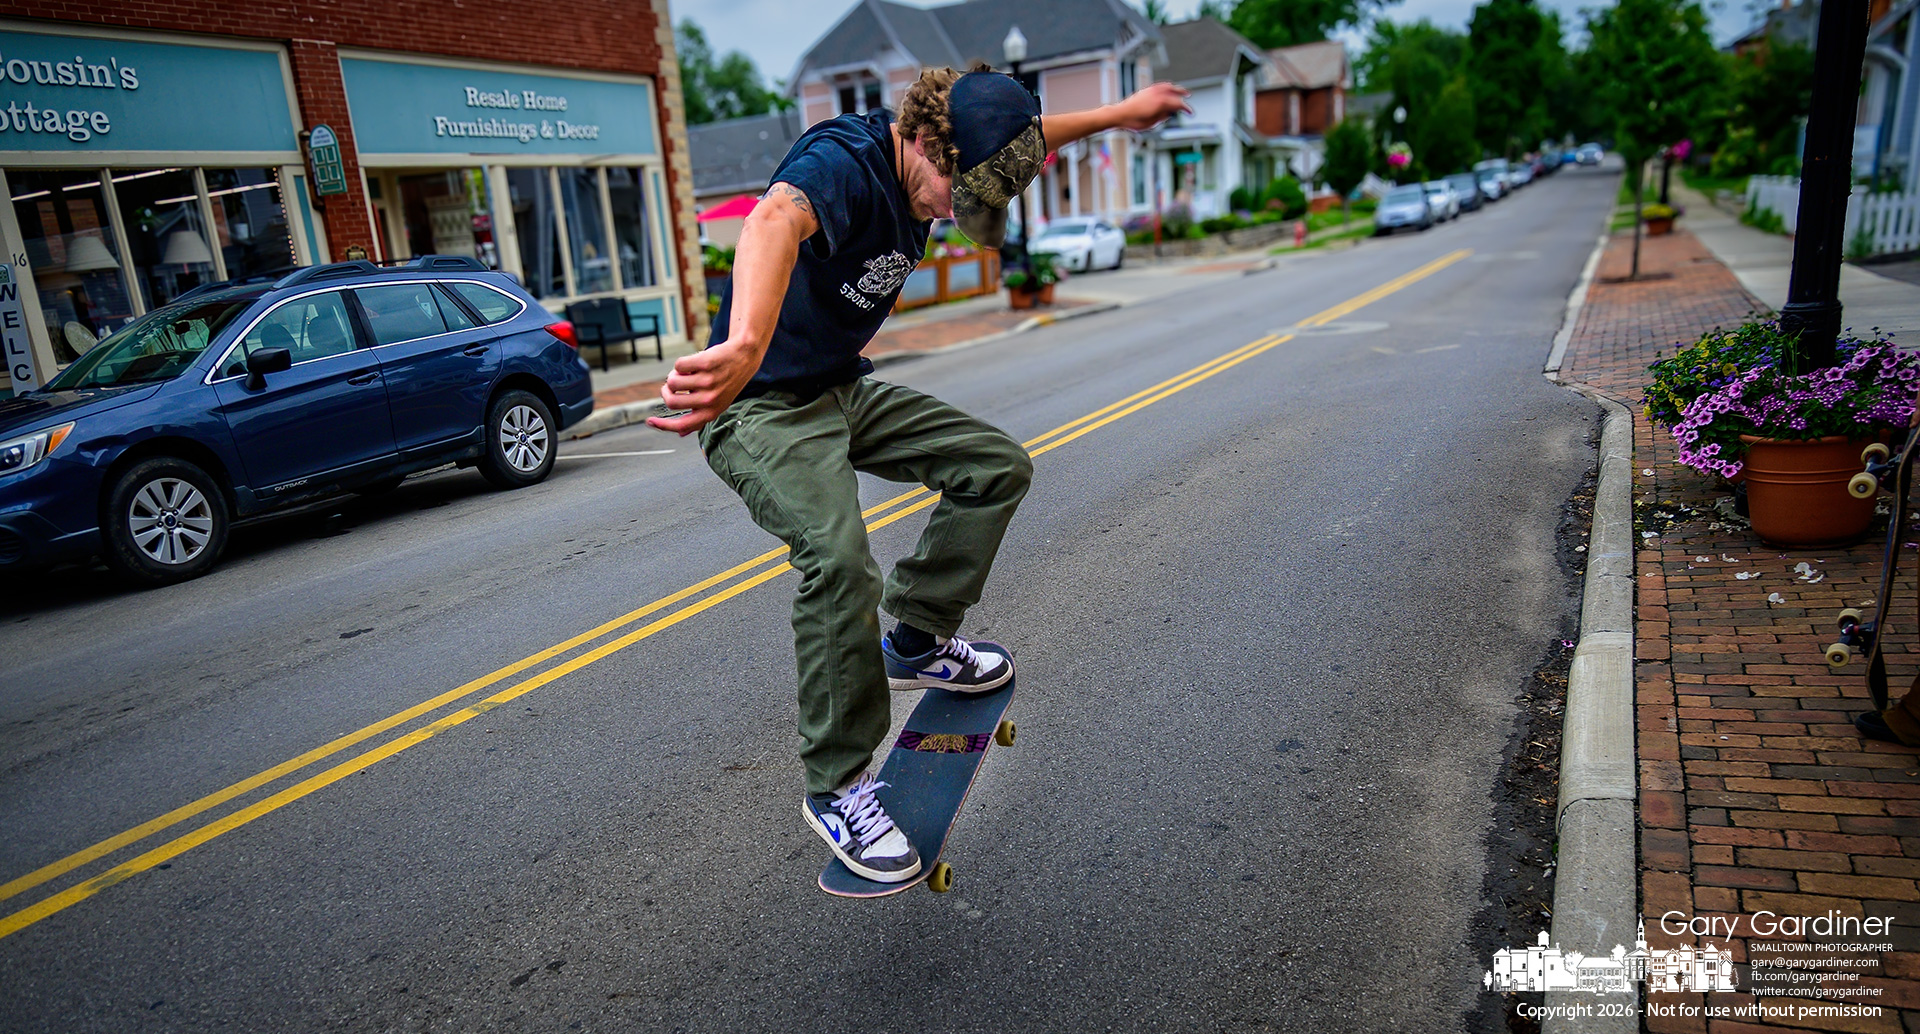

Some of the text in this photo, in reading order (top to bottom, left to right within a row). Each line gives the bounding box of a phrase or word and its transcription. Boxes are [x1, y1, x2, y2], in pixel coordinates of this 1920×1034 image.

[464, 86, 568, 112] Resale Home
[434, 116, 599, 143] Furnishings & Decor
[12, 252, 27, 267] 16
[0, 283, 33, 398] WELC
[274, 479, 308, 492] OUTBACK
